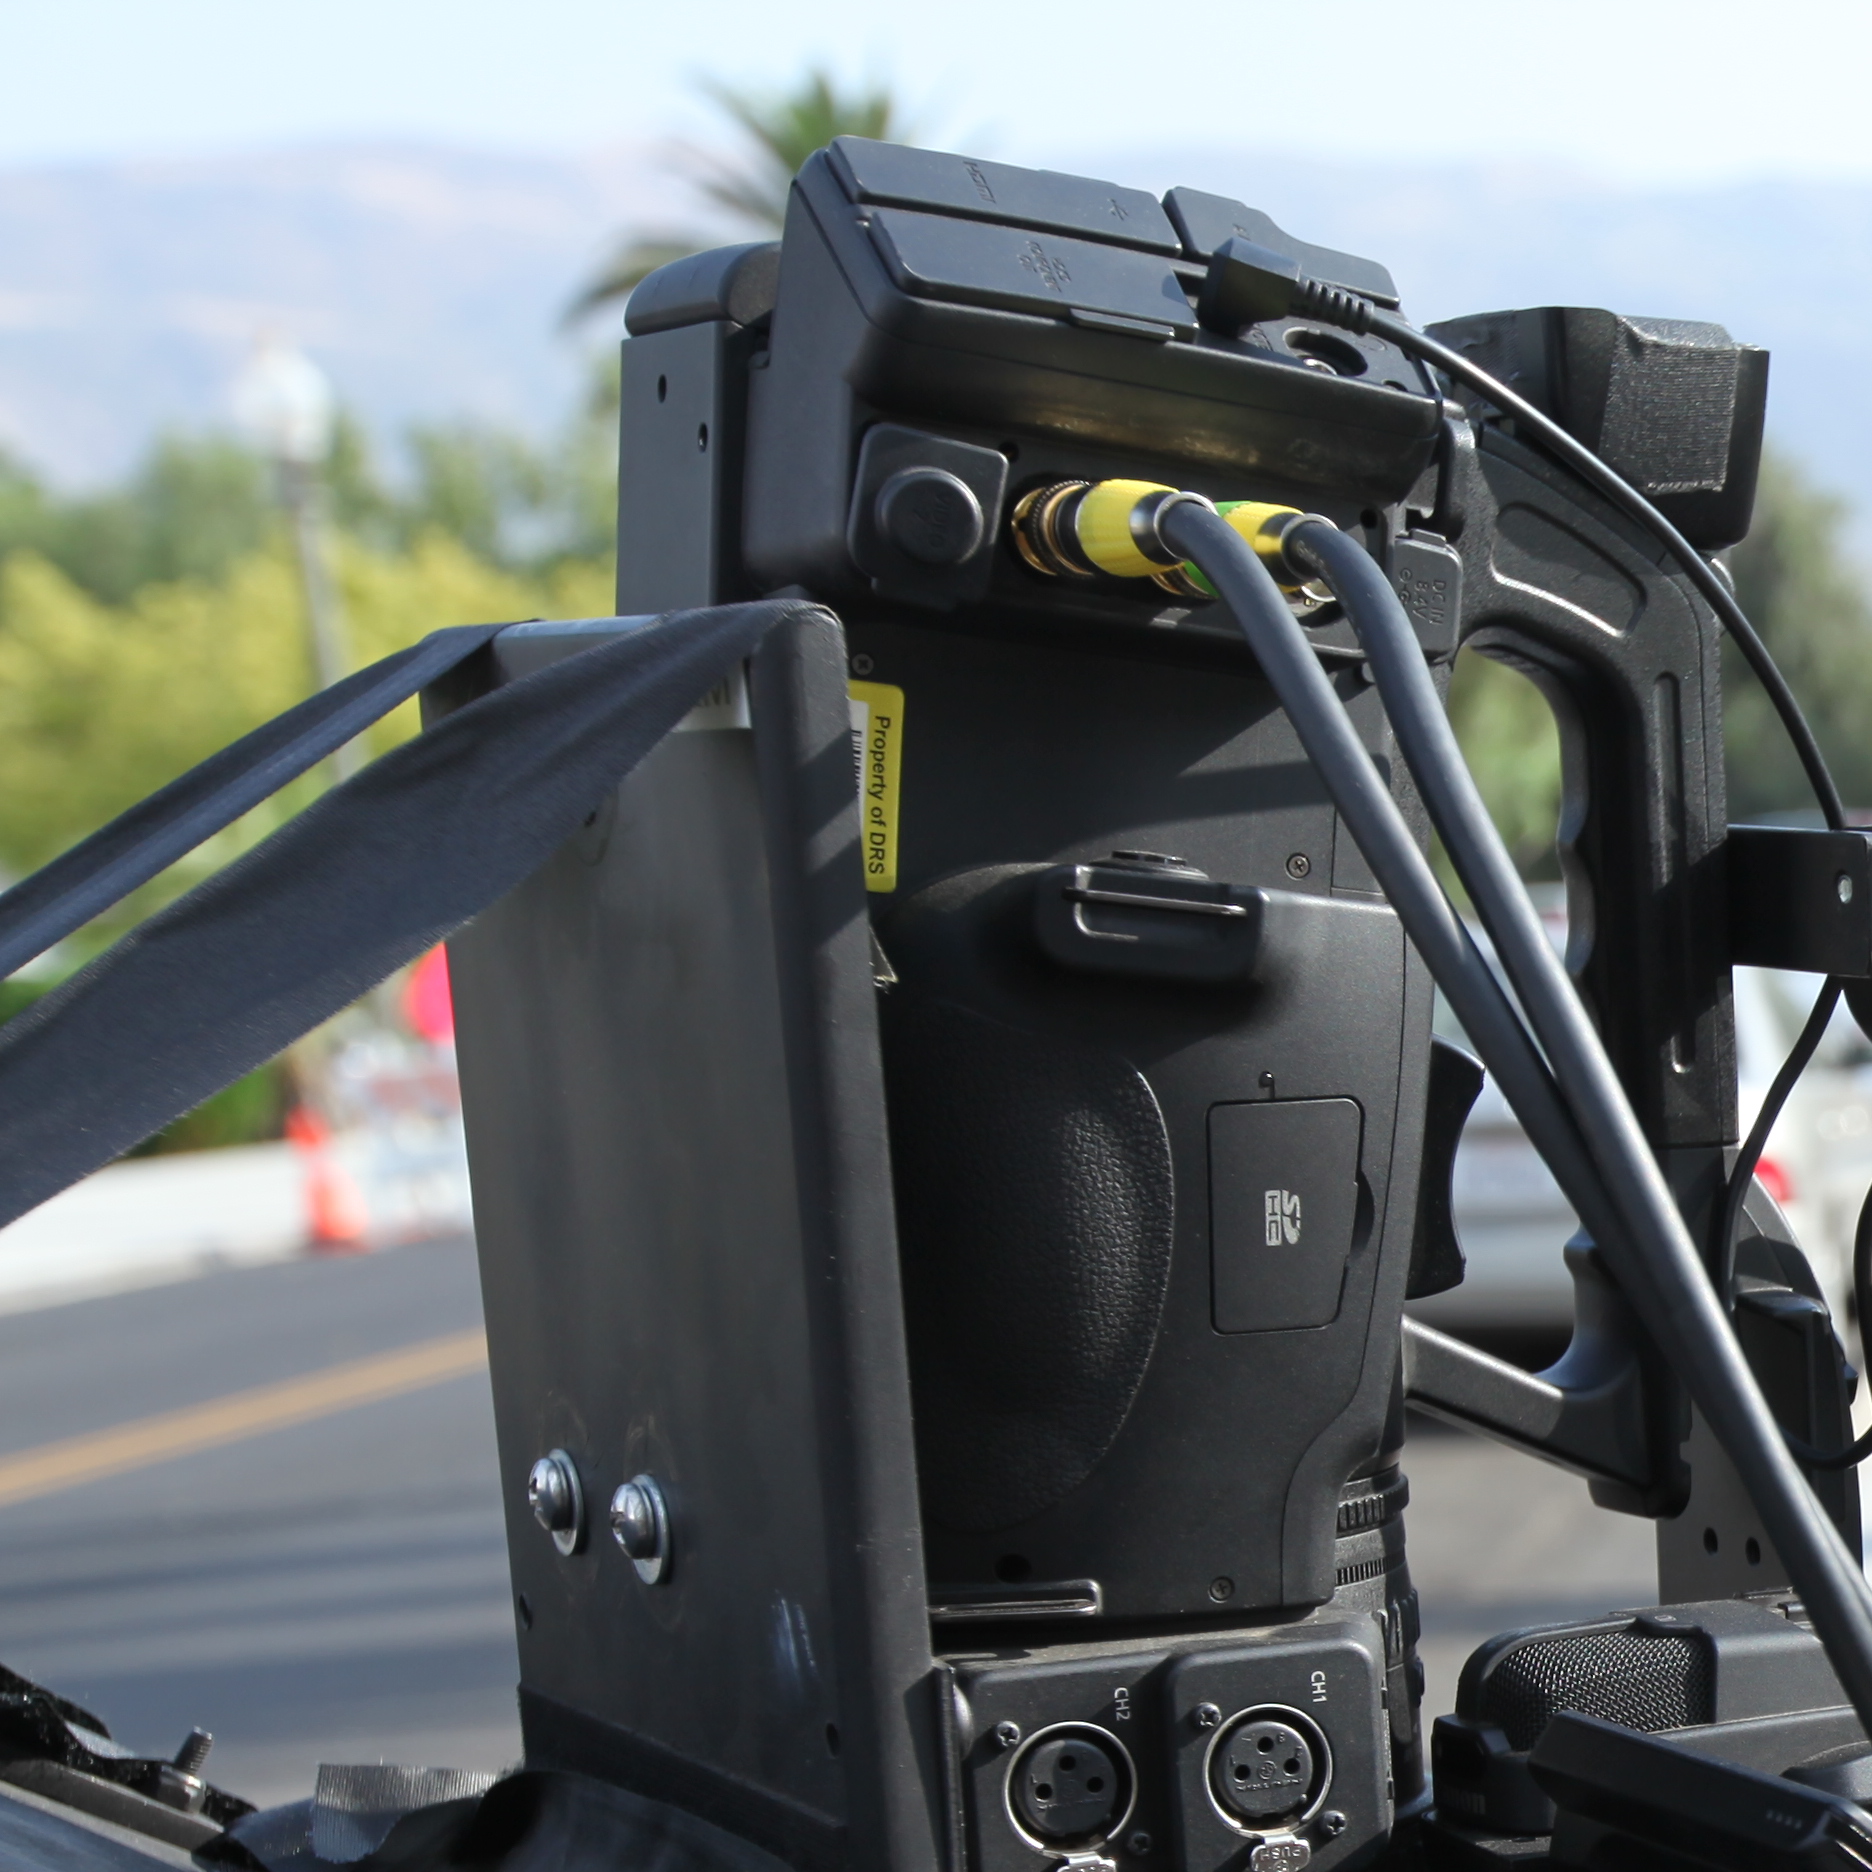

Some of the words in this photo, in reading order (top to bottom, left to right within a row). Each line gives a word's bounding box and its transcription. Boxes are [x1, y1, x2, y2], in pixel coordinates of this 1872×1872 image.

[868, 715, 891, 801] Property
[870, 807, 887, 828] of
[868, 832, 886, 875] DRS
[1310, 1670, 1328, 1703] CH1
[1114, 1687, 1131, 1721] CH2
